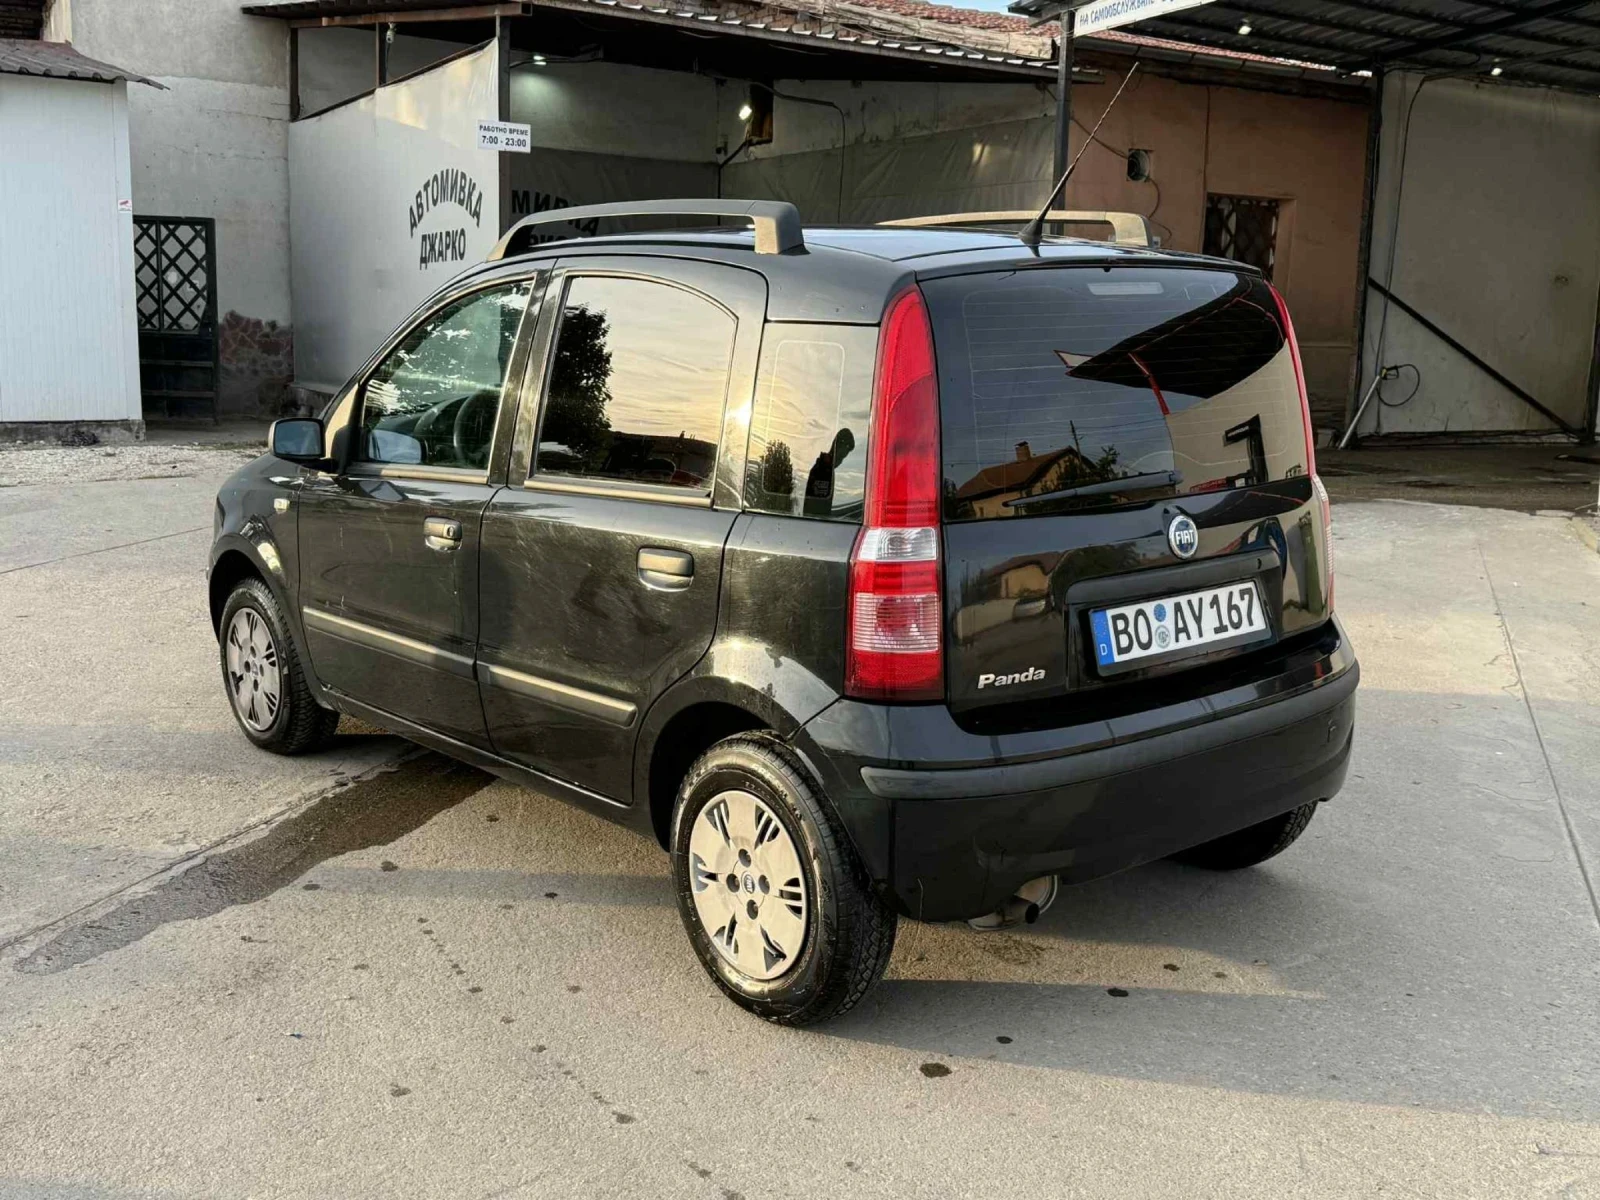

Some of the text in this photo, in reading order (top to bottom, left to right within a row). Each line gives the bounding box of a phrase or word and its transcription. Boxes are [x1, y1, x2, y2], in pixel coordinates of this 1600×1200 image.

[479, 124, 529, 136] РАБОТНО ВРЕМЕ
[481, 135, 499, 145] 7:00
[505, 137, 527, 147] 23:00
[409, 168, 483, 238] АВТОМИВКА
[419, 227, 467, 270] ДЖАРКО
[1175, 529, 1194, 545] FIAT
[1111, 608, 1153, 656] BO
[1100, 643, 1108, 656] D
[977, 666, 1047, 689] Panda
